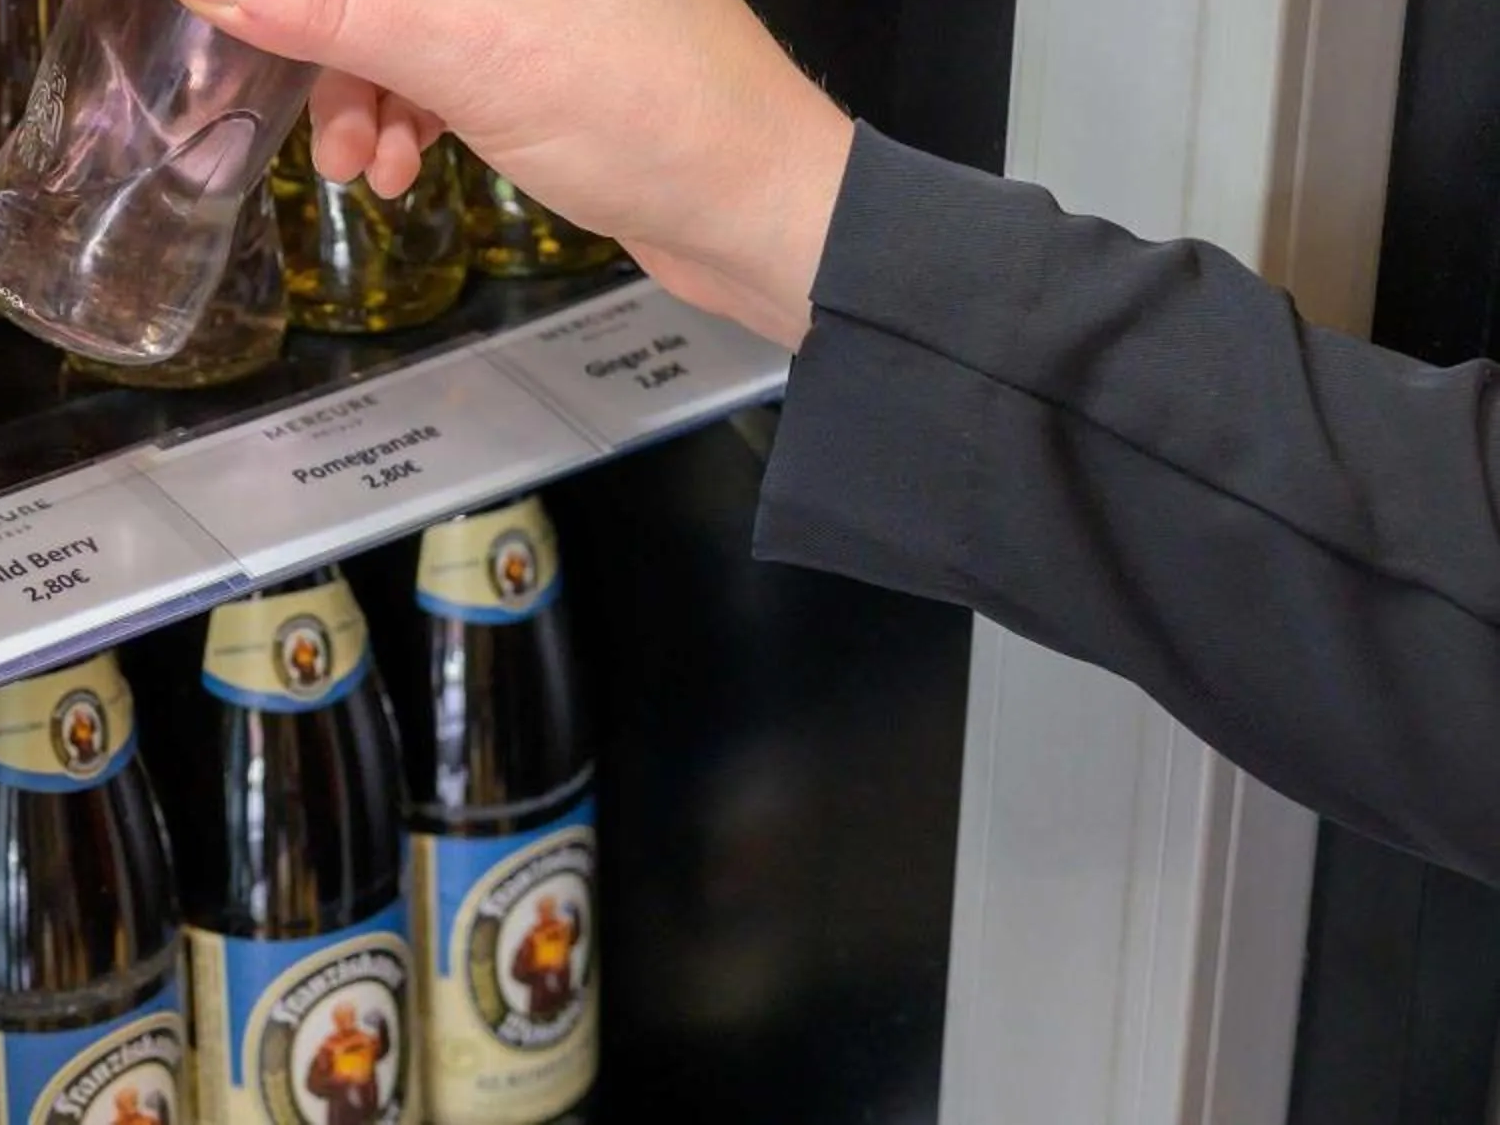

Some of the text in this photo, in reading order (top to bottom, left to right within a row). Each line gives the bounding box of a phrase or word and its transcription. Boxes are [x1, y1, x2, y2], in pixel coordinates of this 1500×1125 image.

[262, 393, 379, 441] MERCURE
[291, 425, 443, 484] Pomegranate
[361, 459, 423, 490] 2,80€
[26, 535, 100, 568] Berry
[22, 568, 91, 603] 2,80€
